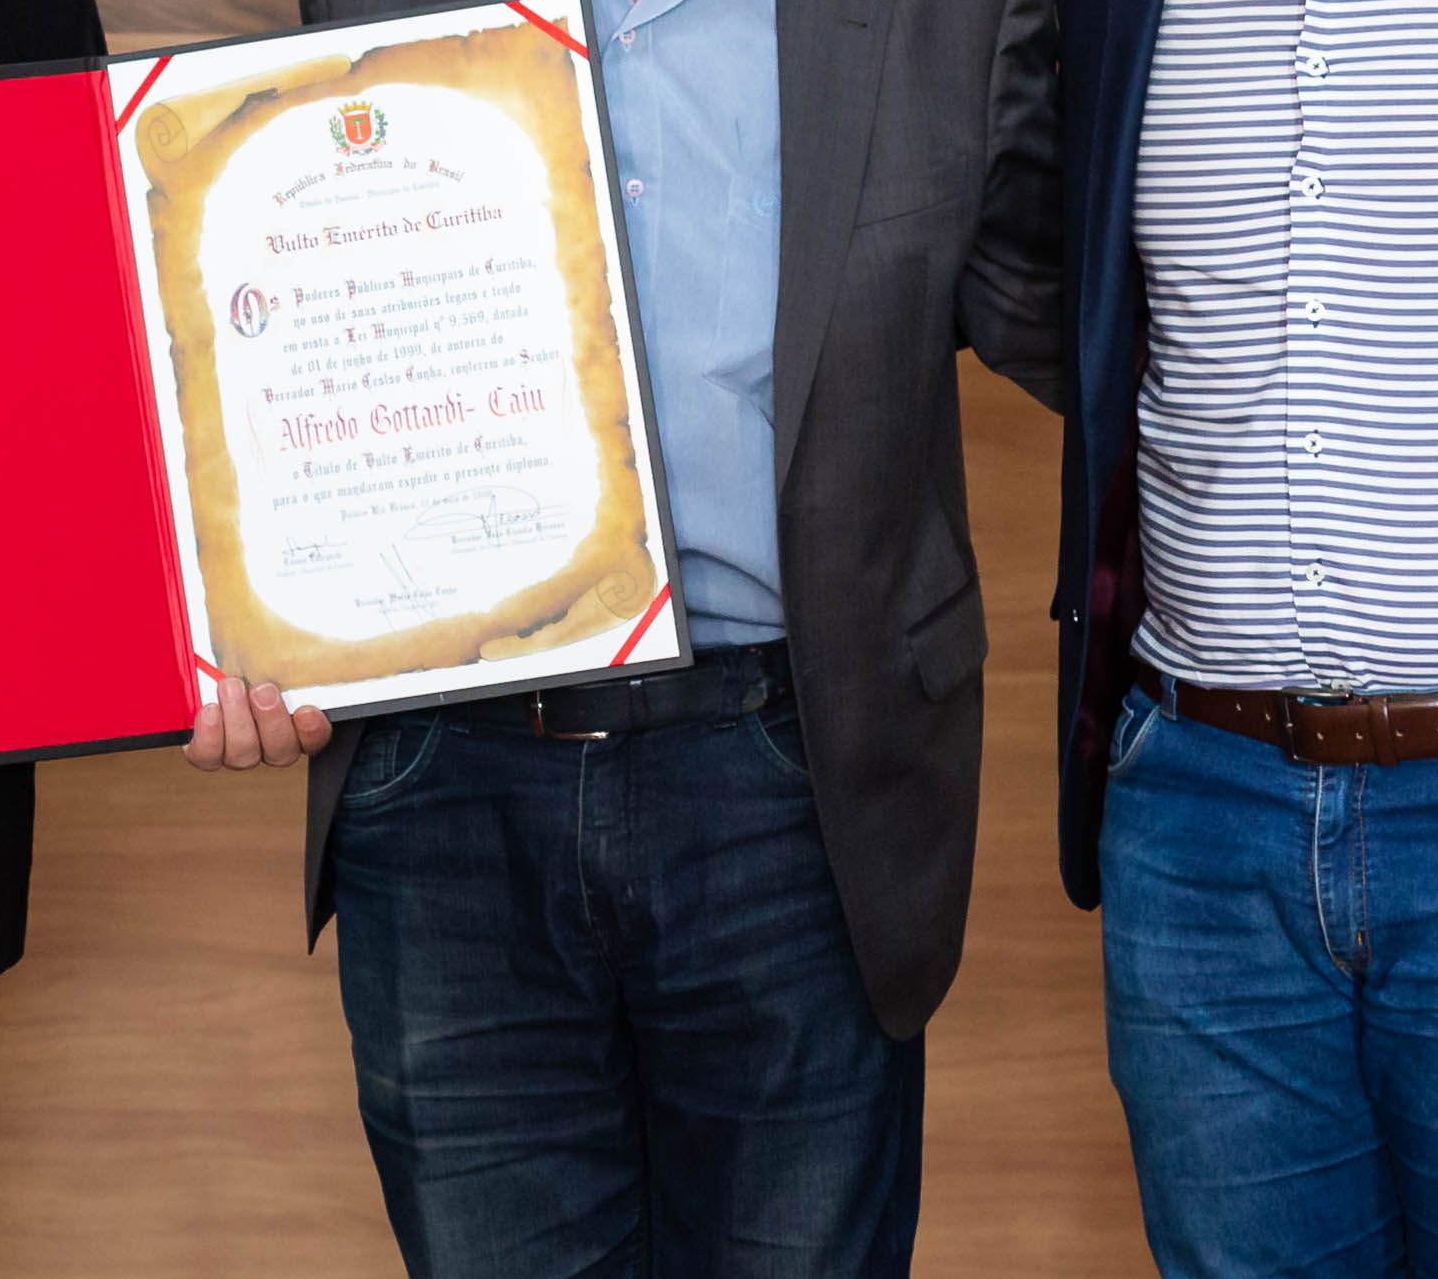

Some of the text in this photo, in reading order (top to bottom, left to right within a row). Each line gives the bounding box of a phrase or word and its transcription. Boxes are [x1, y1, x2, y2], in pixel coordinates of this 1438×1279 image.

[428, 158, 466, 182] Brasil
[266, 205, 503, 255] Vulto Emérito de Curitiba
[293, 288, 340, 308] Poderes
[400, 269, 464, 287] Municipais
[468, 265, 479, 277] de
[293, 316, 307, 330] no
[312, 312, 330, 324] uso
[335, 309, 346, 321] de
[352, 306, 376, 318] suas
[445, 291, 477, 306] legais
[492, 282, 521, 298] tendo
[283, 343, 298, 353] em
[303, 337, 329, 351] vista
[345, 328, 367, 343] Lei
[372, 319, 429, 339] Municipal
[493, 305, 529, 321] datada
[262, 386, 314, 404] Vereador
[451, 358, 499, 375] conferem
[503, 356, 515, 366] ao
[520, 348, 560, 365] Senhor
[291, 363, 303, 376] de
[326, 357, 337, 370] de
[343, 353, 372, 369] junho
[377, 351, 388, 362] de
[430, 342, 442, 354] de
[447, 338, 486, 352] autoria
[491, 332, 504, 345] do
[280, 406, 358, 452] Alfredo
[346, 459, 358, 471] de
[362, 452, 397, 469] Vulto
[457, 443, 469, 455] de
[273, 496, 298, 510] para
[313, 489, 332, 505] que
[337, 480, 394, 499] mandaram
[398, 473, 438, 492] expedir
[455, 464, 501, 482] presente
